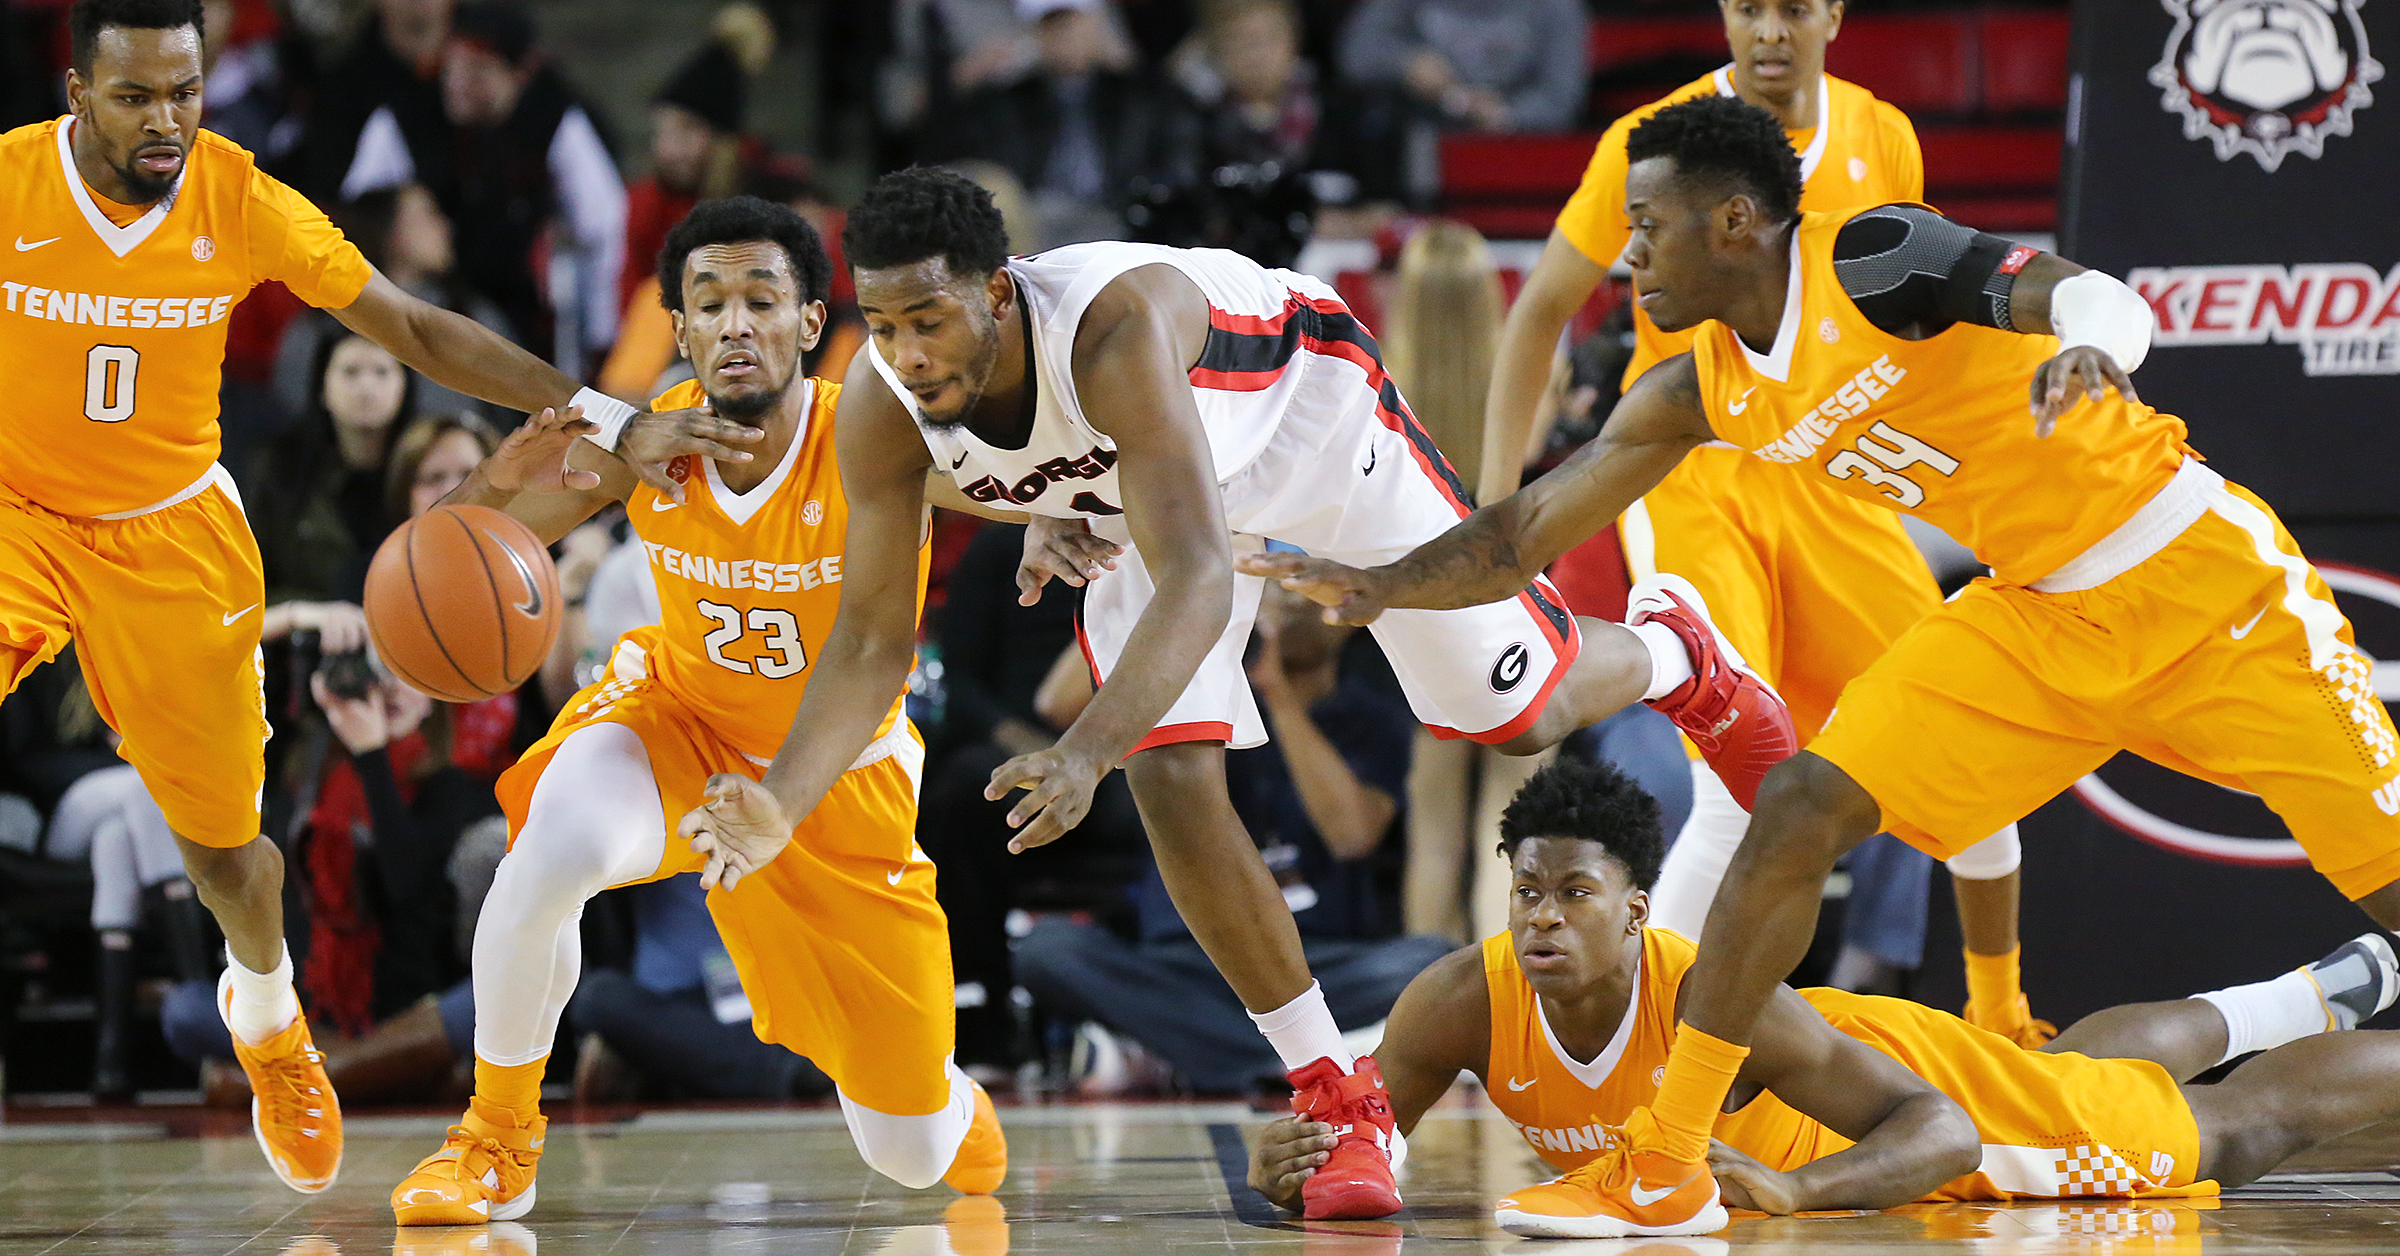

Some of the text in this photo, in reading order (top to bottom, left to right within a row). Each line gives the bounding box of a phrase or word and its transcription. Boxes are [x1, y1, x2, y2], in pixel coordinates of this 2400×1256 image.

[192, 238, 215, 261] SEC
[1, 281, 233, 328] TENNESSEE
[84, 344, 140, 422] 0
[1826, 419, 1962, 508] 34
[802, 501, 823, 525] SEC
[643, 540, 843, 592] TENNESSEE
[697, 598, 808, 679] 23
[1489, 643, 1529, 693] G
